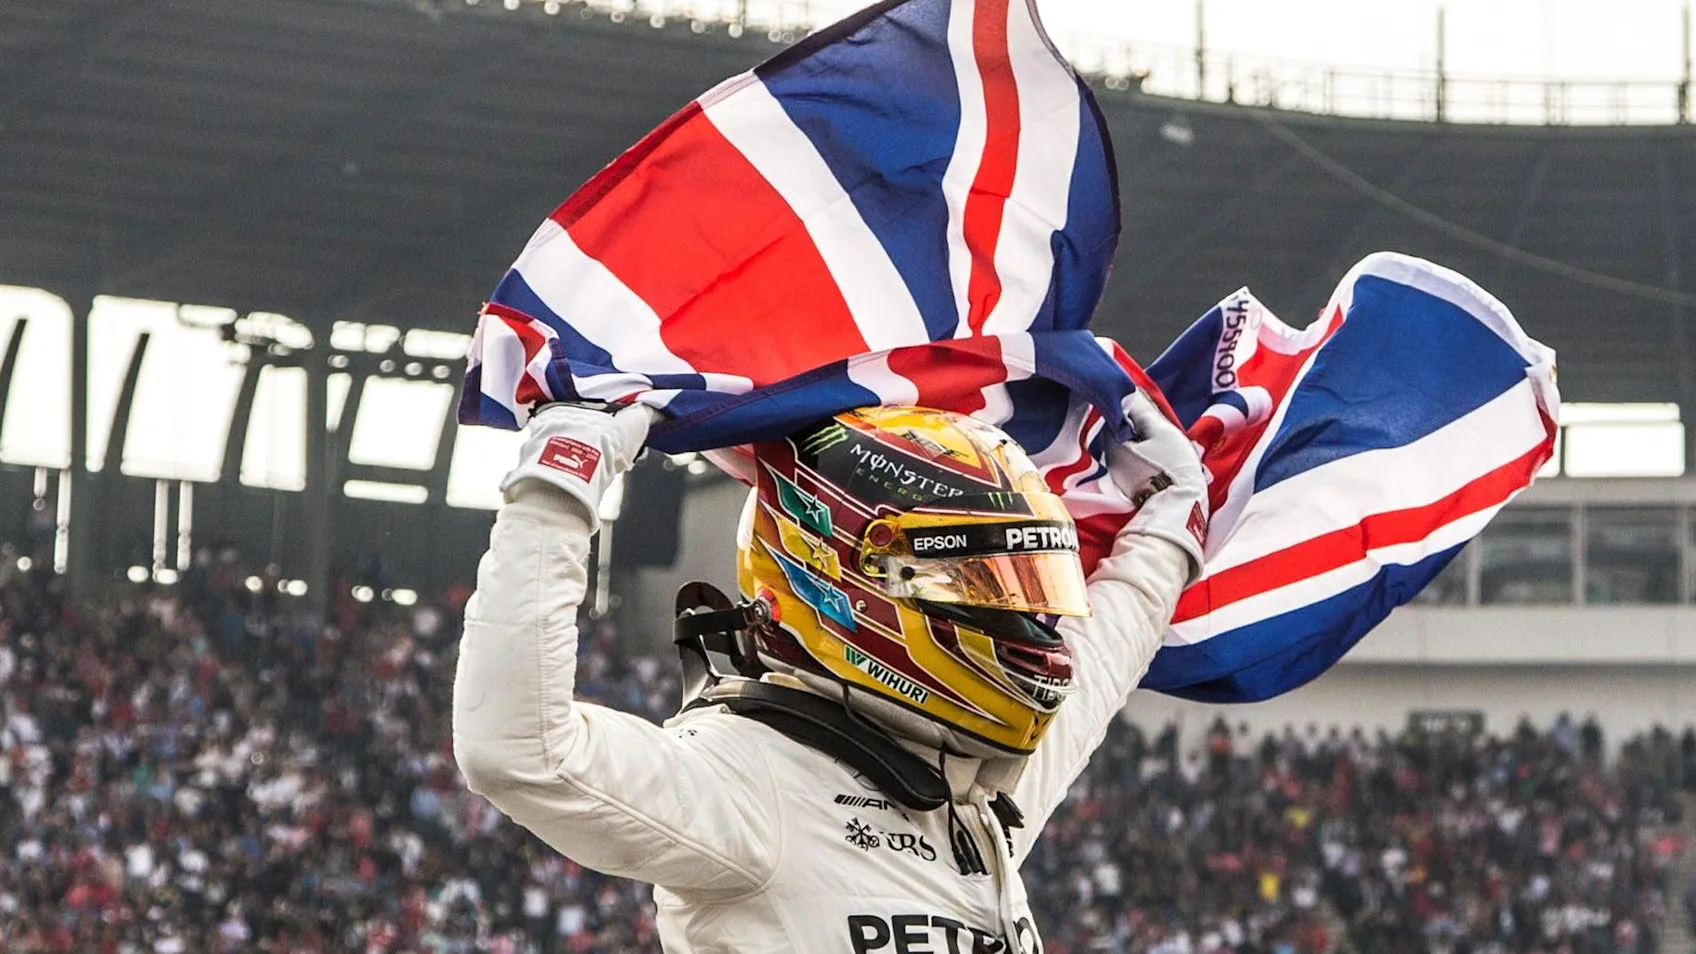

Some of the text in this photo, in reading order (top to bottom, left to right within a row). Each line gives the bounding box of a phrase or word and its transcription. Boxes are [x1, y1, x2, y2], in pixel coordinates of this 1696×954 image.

[850, 443, 964, 498] MONSTER
[855, 467, 923, 502] ENERG
[913, 533, 967, 551] EPSON
[867, 660, 930, 705] WIHURI
